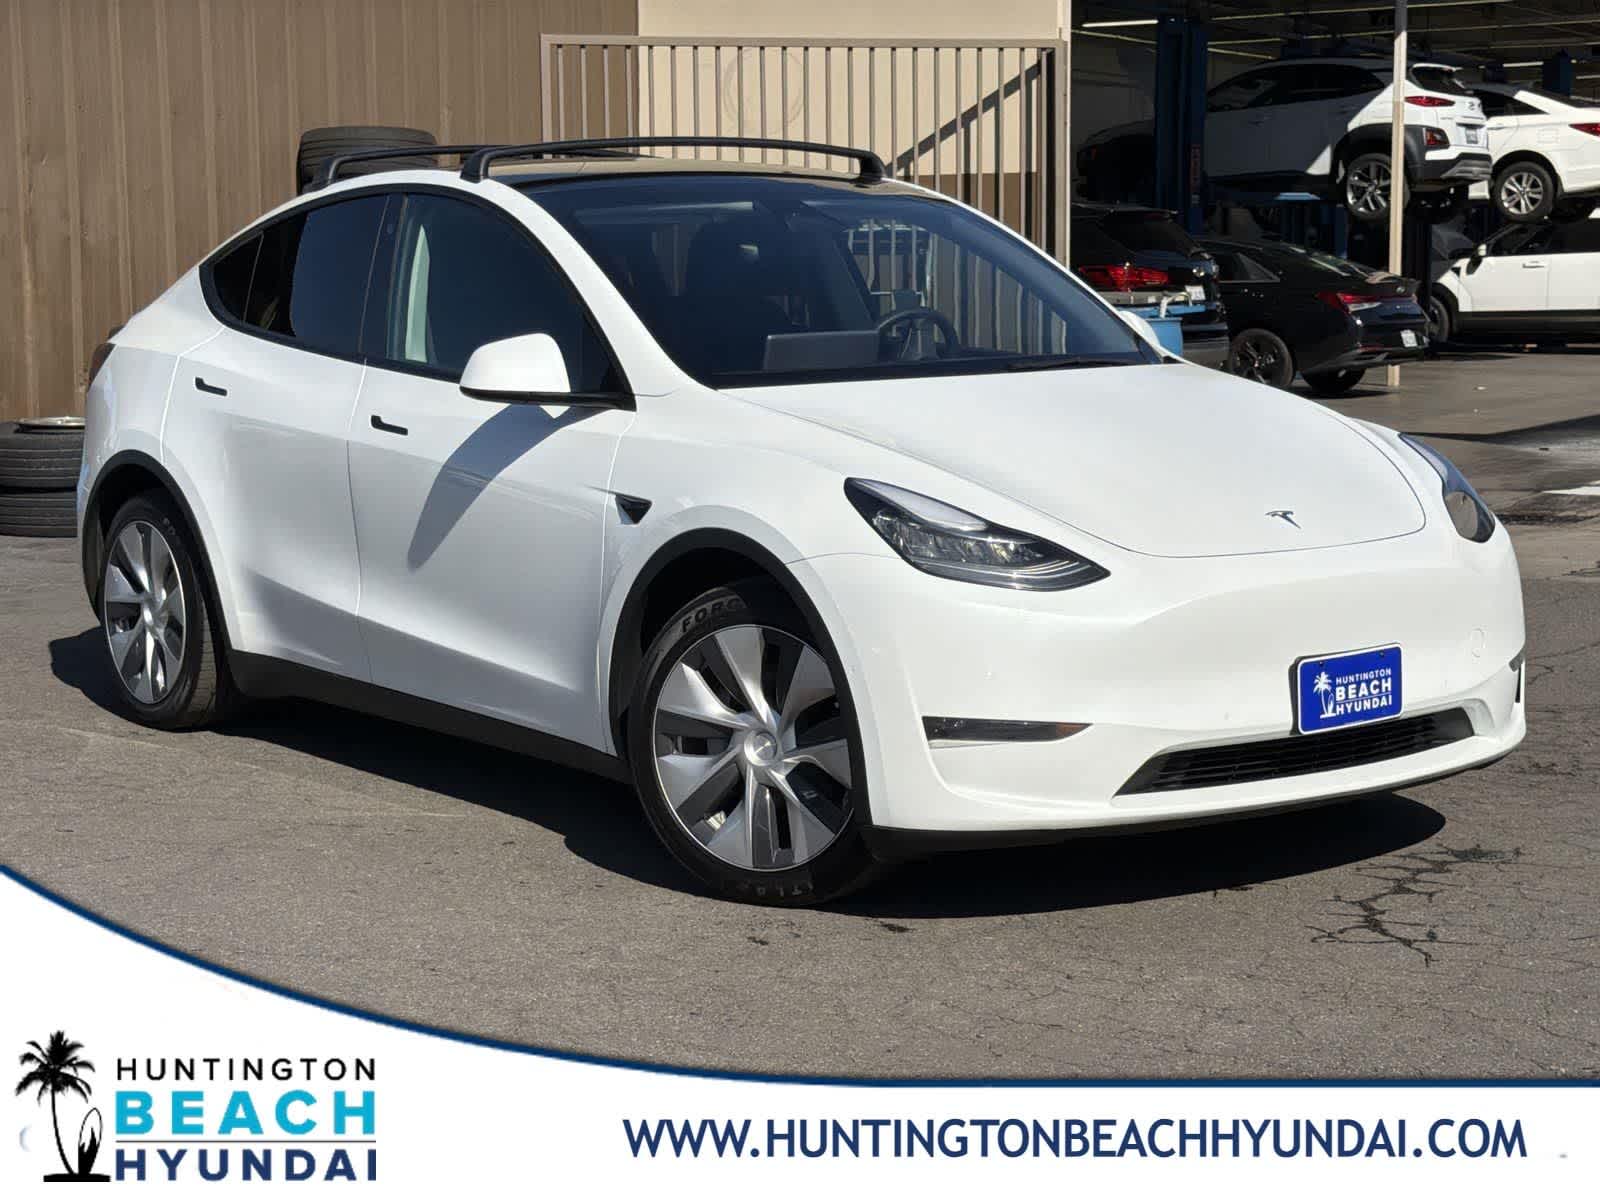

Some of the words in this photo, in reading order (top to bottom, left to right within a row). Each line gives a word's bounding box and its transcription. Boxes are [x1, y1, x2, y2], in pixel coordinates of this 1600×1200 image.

[1335, 668, 1392, 685] HUNTINGTON
[1335, 677, 1392, 701] BEACH
[1336, 695, 1392, 715] HYUNDAI
